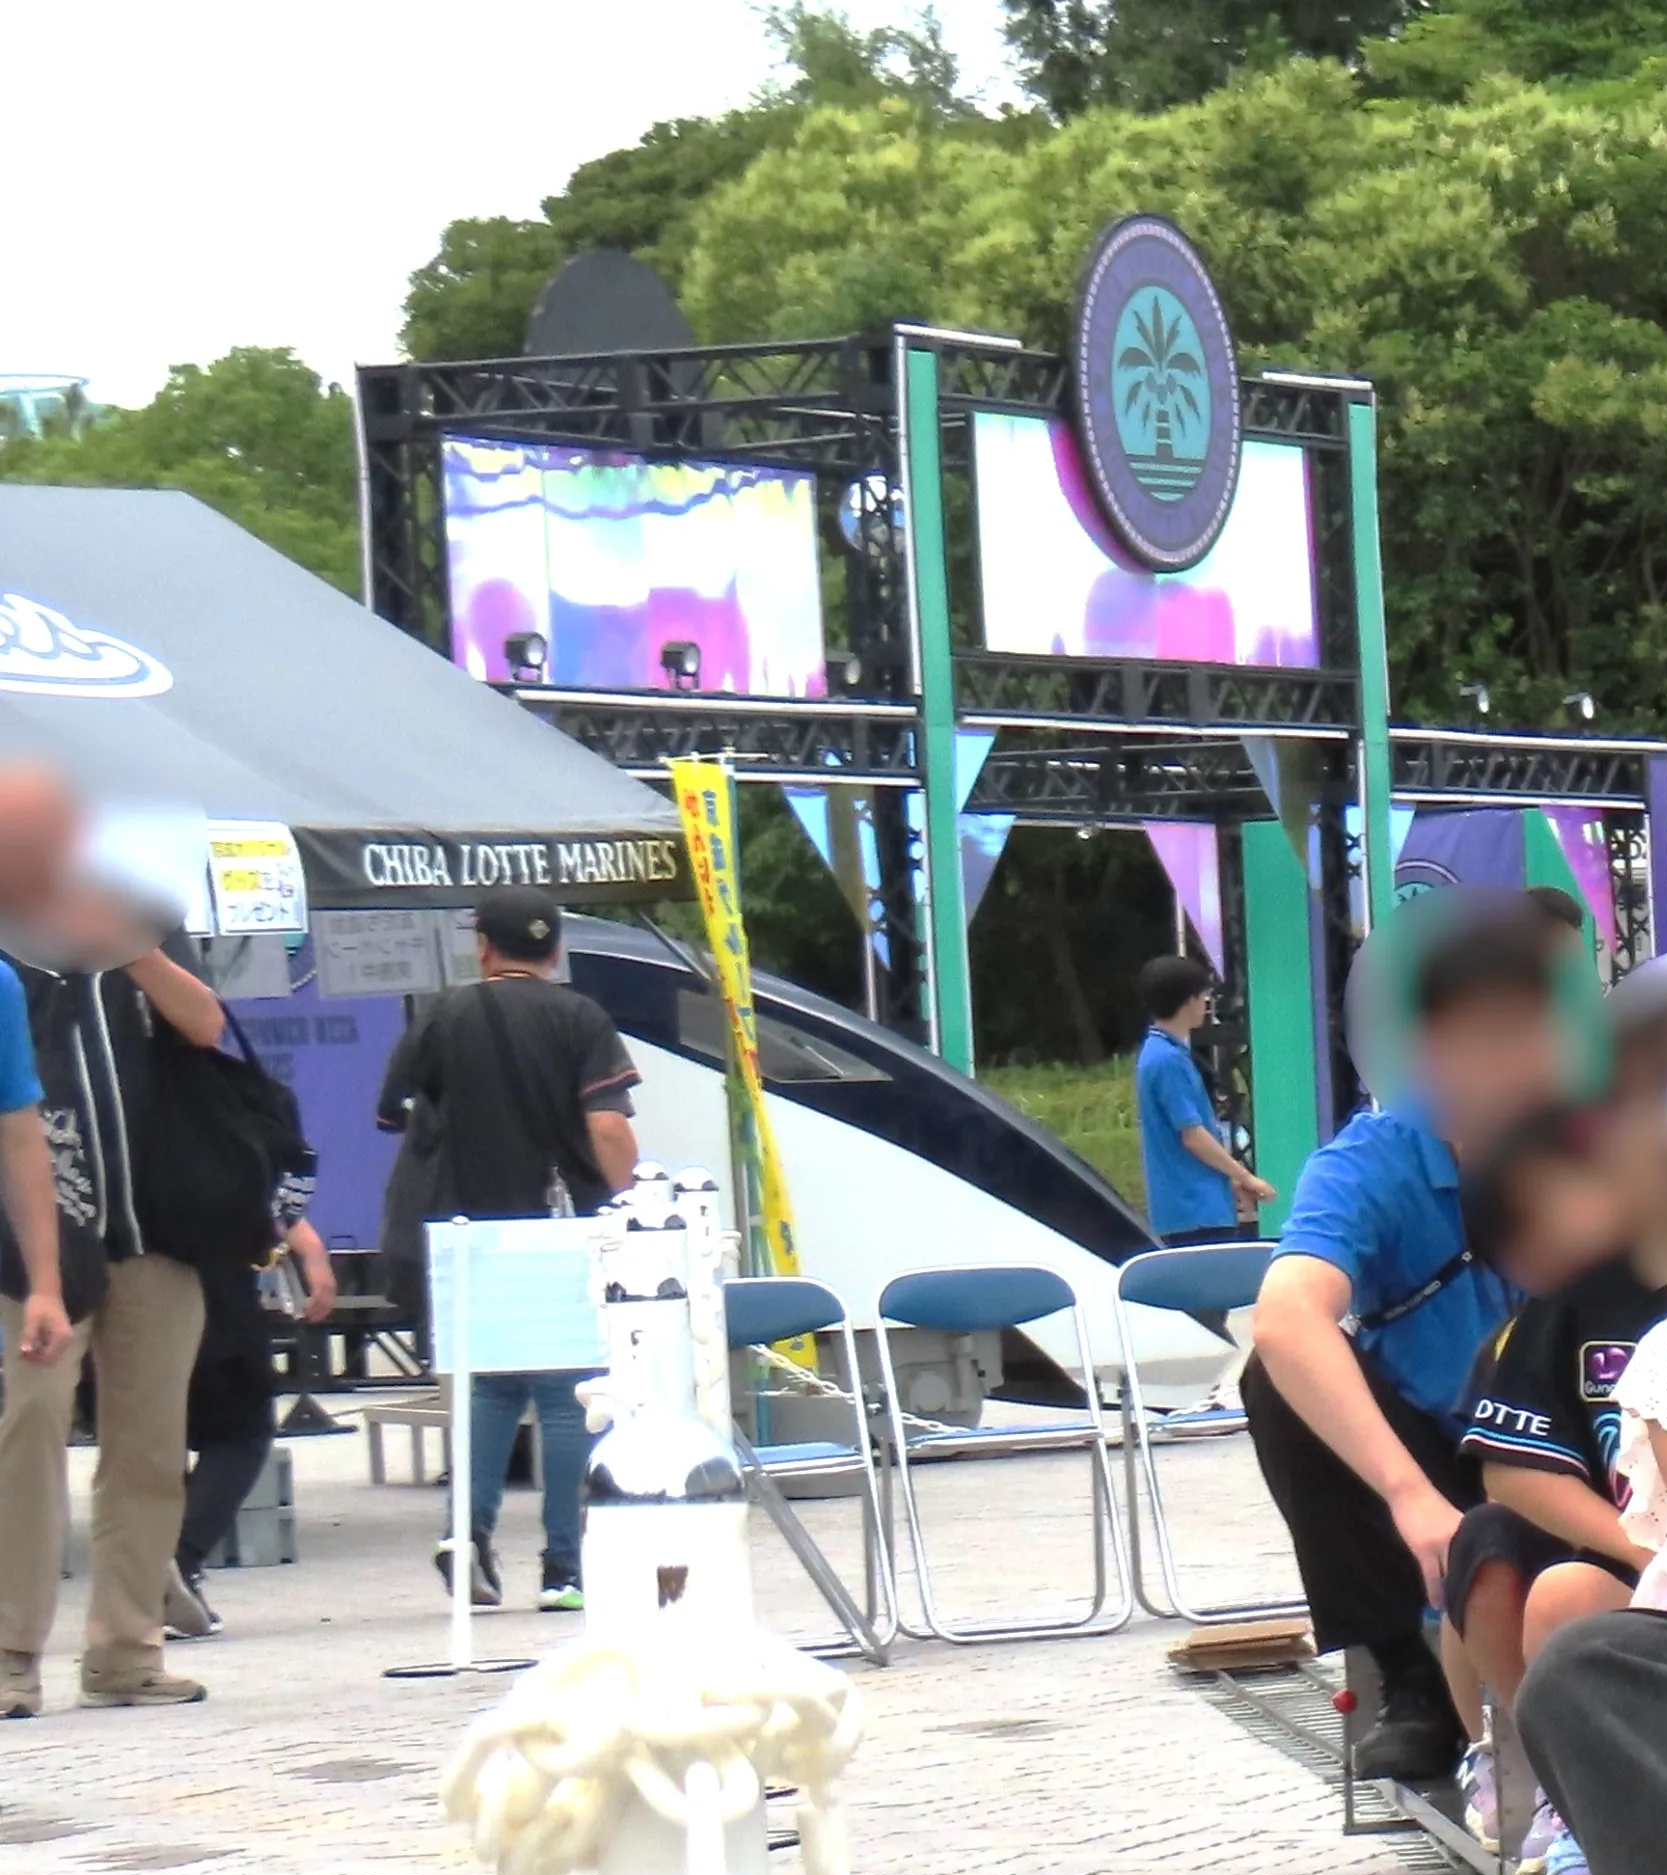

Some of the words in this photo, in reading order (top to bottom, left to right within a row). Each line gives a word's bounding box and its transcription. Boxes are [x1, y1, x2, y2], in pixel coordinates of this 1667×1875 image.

[364, 843, 454, 887] CHIBA
[460, 843, 551, 887] LOTTE
[556, 839, 678, 884] MARINES
